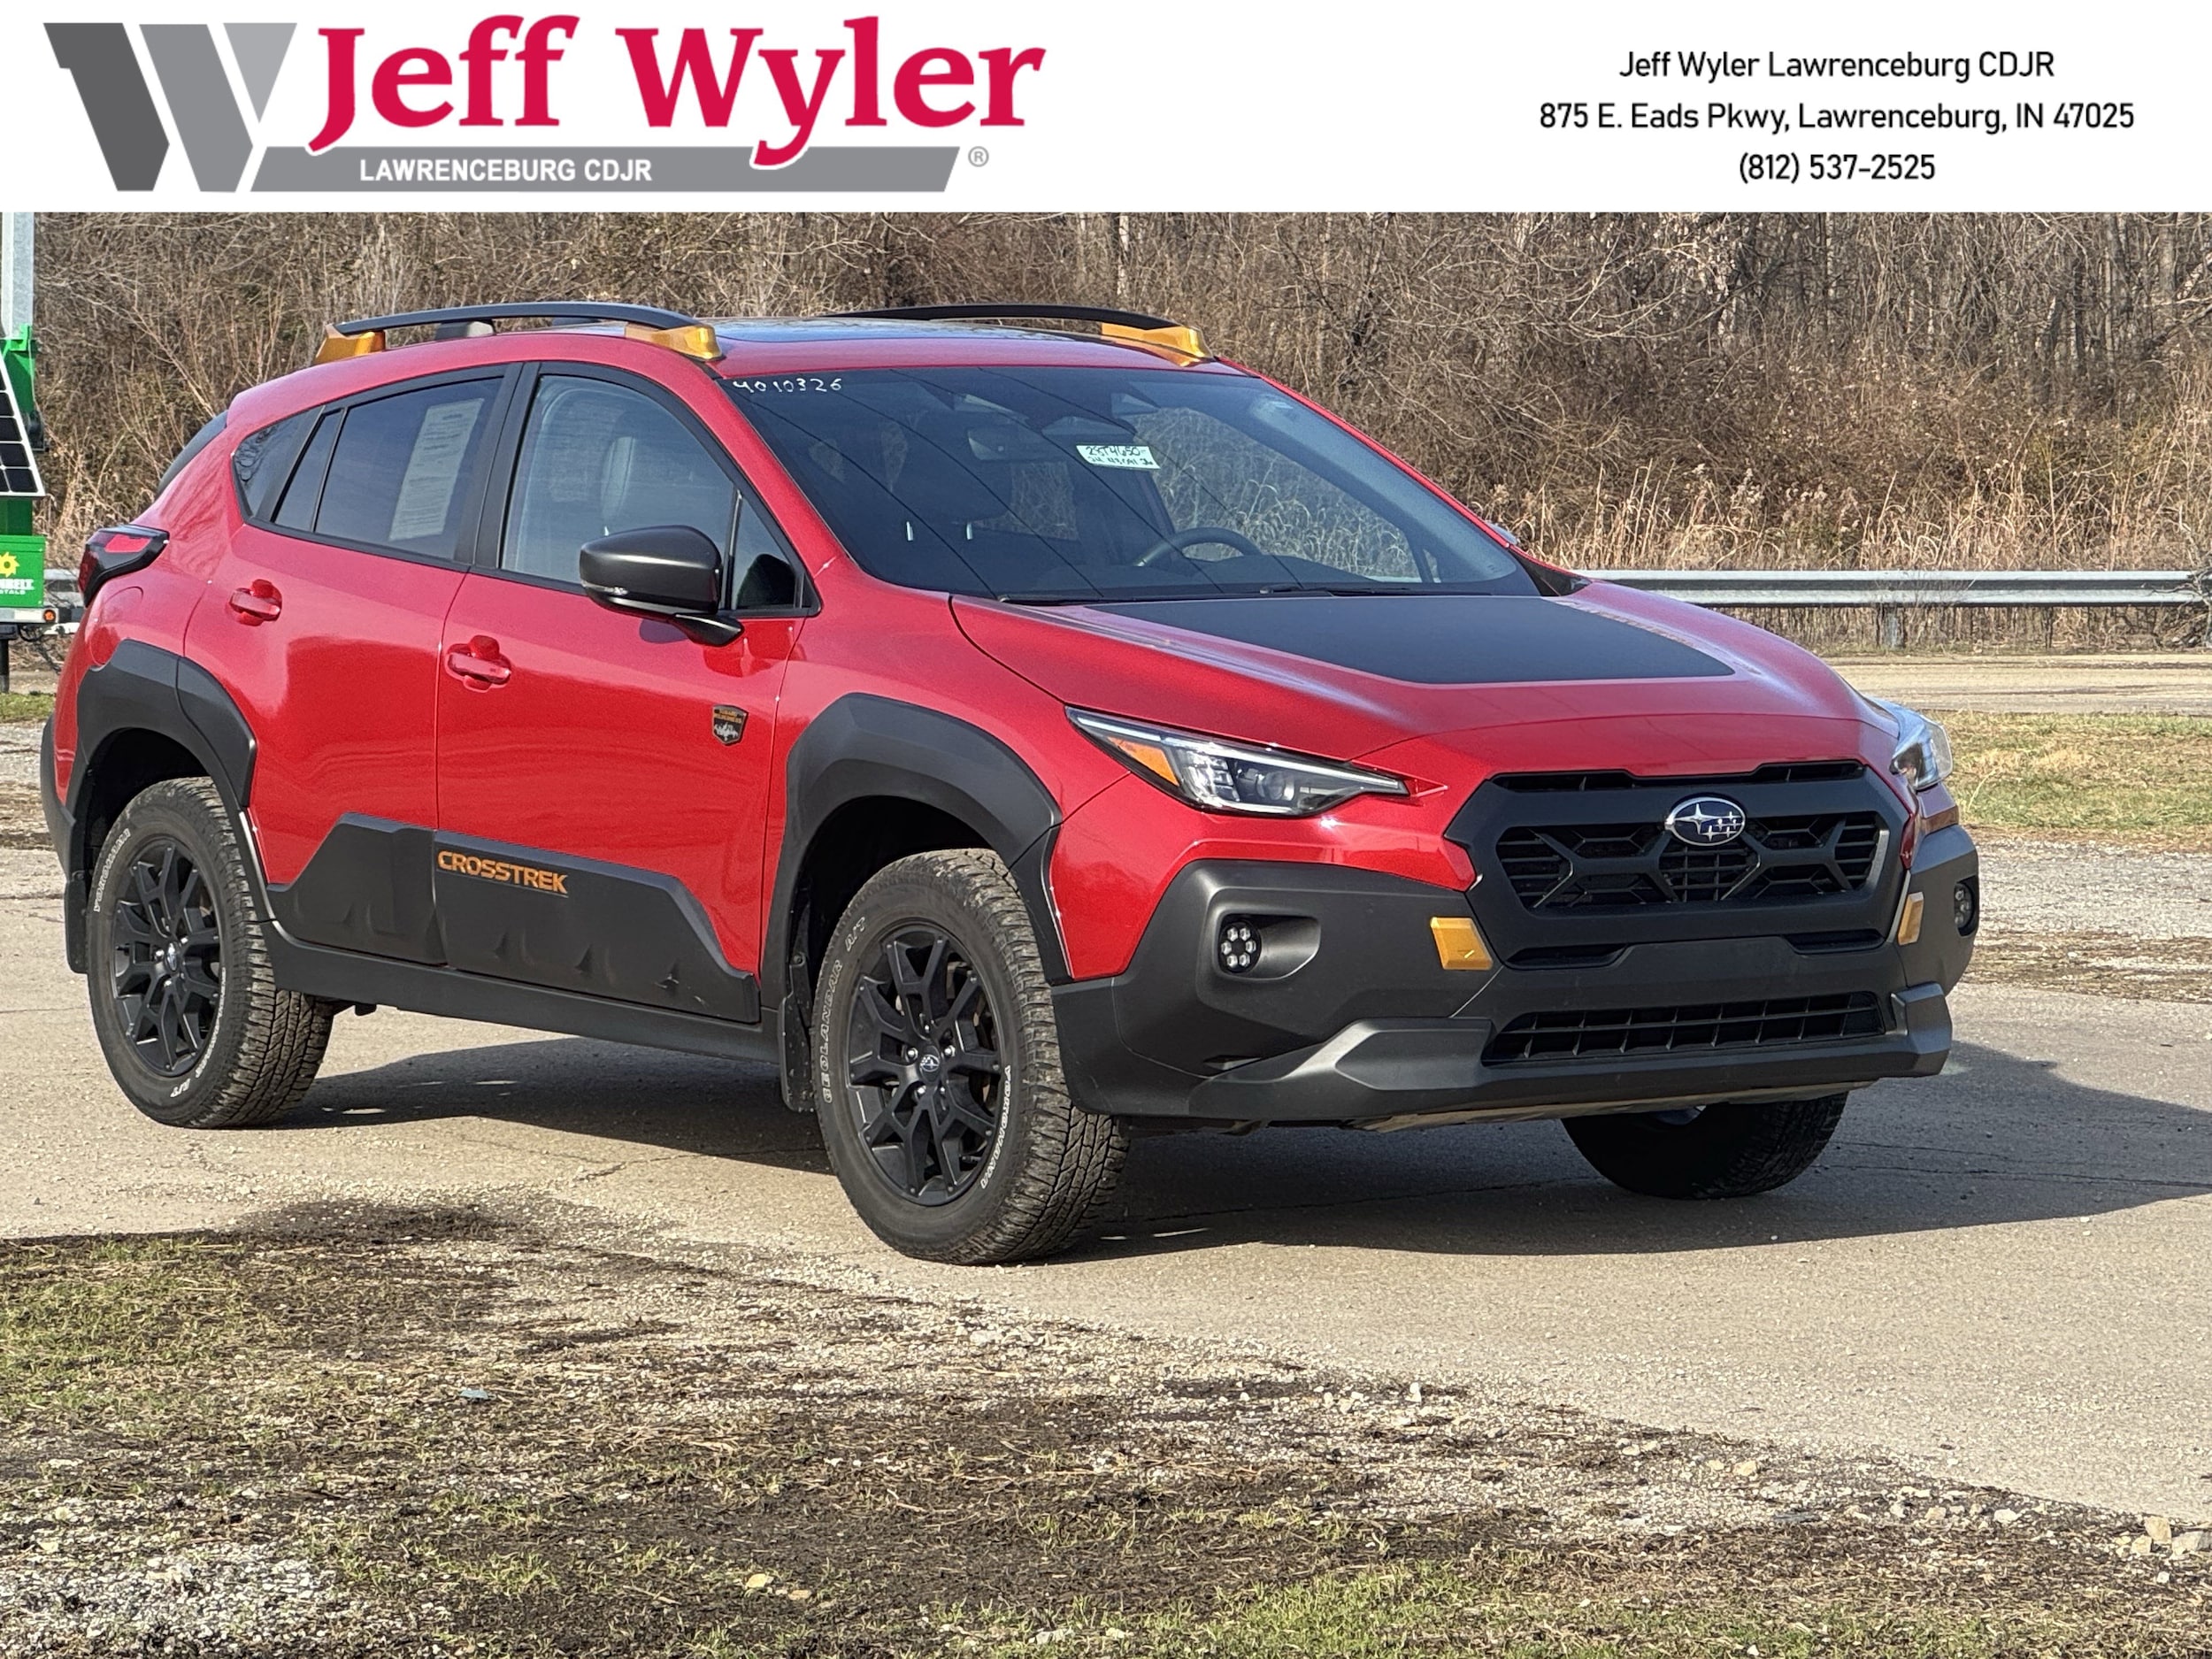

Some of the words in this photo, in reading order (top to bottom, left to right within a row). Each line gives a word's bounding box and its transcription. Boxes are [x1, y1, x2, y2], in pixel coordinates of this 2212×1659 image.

[733, 378, 842, 393] 4010326
[437, 850, 569, 895] CROSSTREK
[819, 959, 842, 1104] GEOLANDAR
[979, 1064, 1011, 1189] YOKOHAMA
